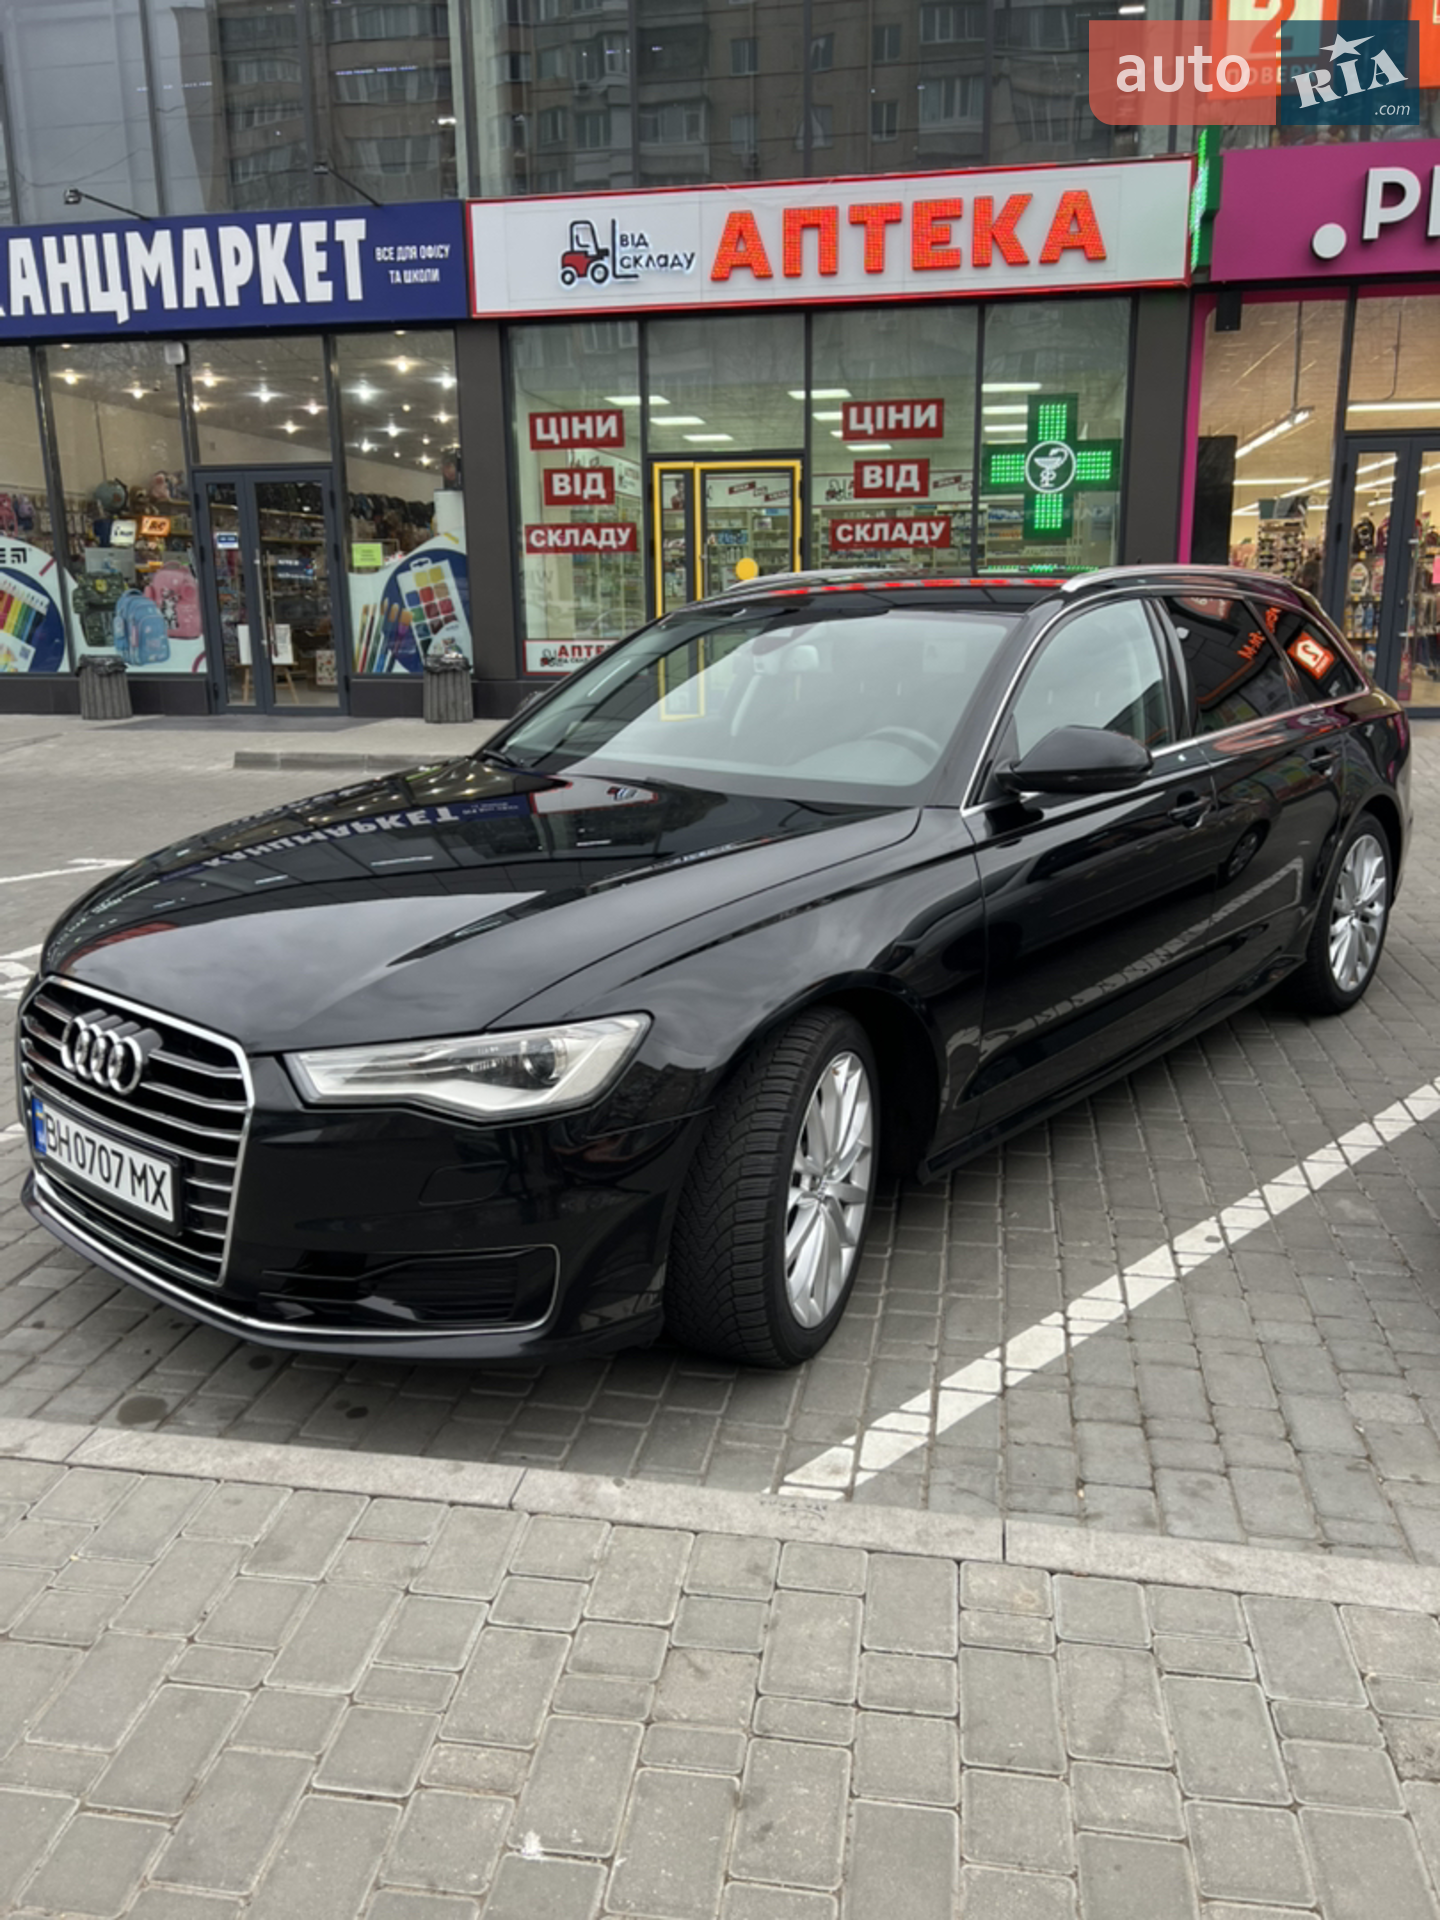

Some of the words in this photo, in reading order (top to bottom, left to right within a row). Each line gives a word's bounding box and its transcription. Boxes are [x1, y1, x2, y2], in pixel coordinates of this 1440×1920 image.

[619, 232, 649, 248] ВІД
[711, 189, 1106, 281] АПТЕКА
[374, 246, 395, 262] ВСЕ
[396, 245, 417, 262] ДЛЯ
[419, 243, 451, 260] ОФІСУ
[0, 218, 366, 324] АНЦМАРКЕТ
[388, 269, 402, 284] ТА
[403, 268, 440, 284] ШКОЛИ
[535, 414, 617, 445] ЦІНИ
[850, 403, 937, 435] ЦІНИ
[552, 472, 606, 499] ВІД
[863, 463, 920, 492] ВІД
[529, 527, 632, 548] СКЛАДУ
[836, 520, 946, 544] СКЛАДУ
